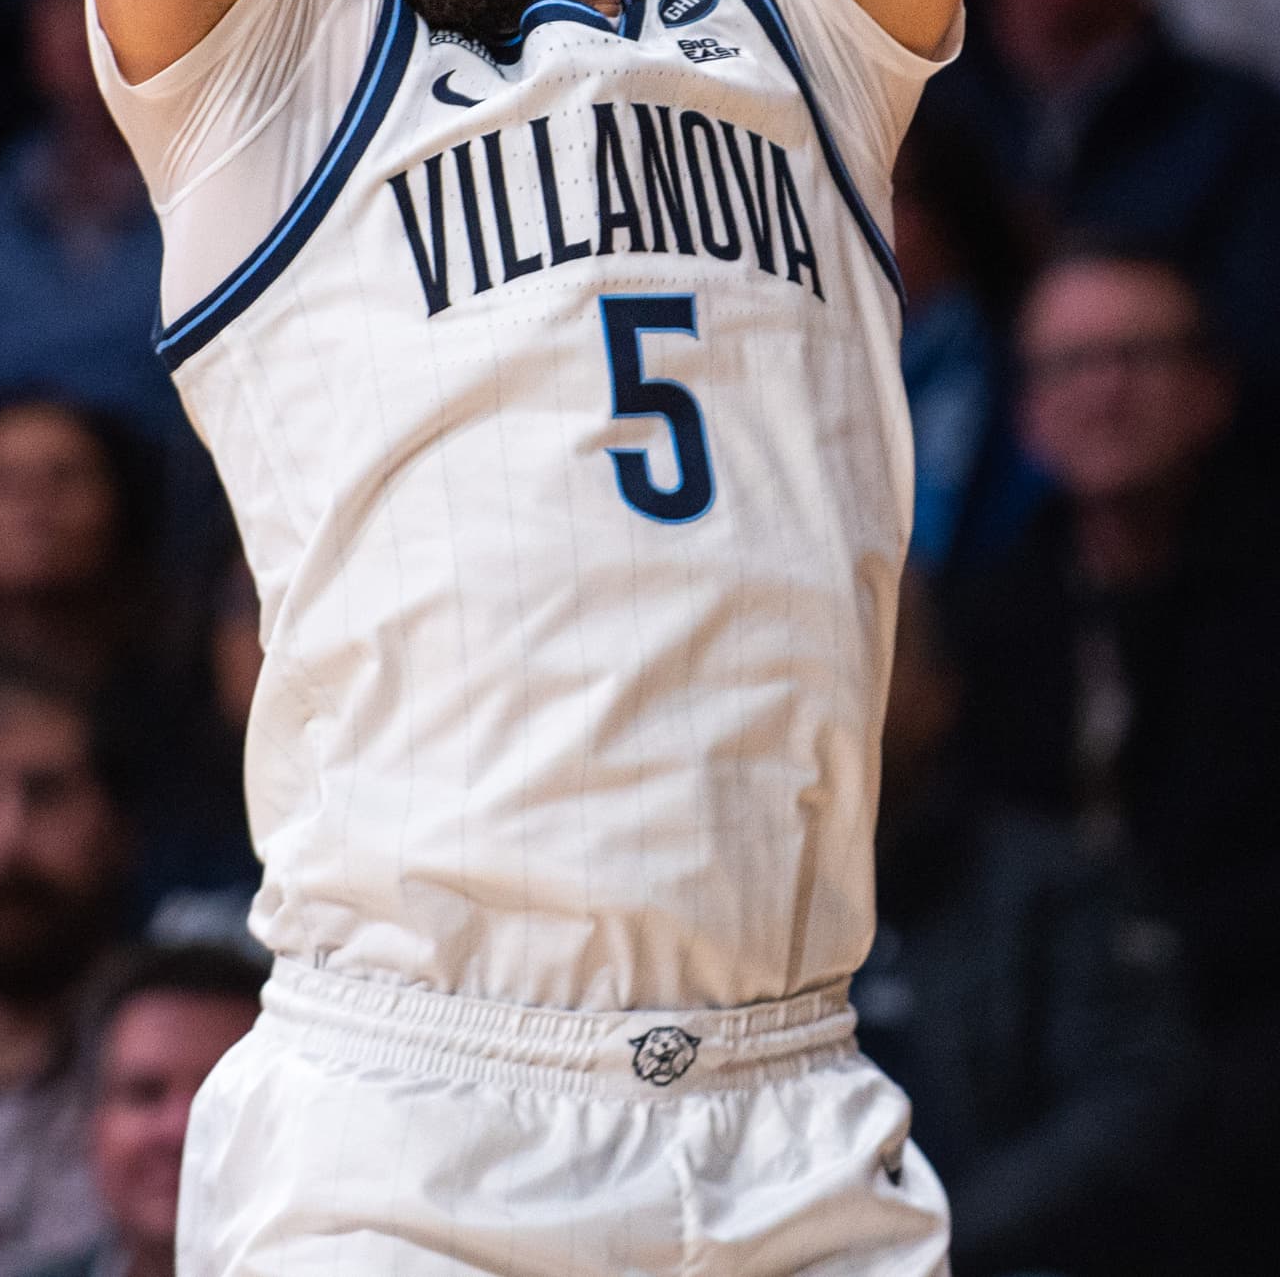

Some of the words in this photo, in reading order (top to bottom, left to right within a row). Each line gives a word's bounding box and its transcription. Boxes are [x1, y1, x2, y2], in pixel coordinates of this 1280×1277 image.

[677, 37, 719, 51] BIG
[683, 47, 741, 61] EAST
[387, 102, 826, 318] VILLANOVA
[598, 292, 717, 525] 5
